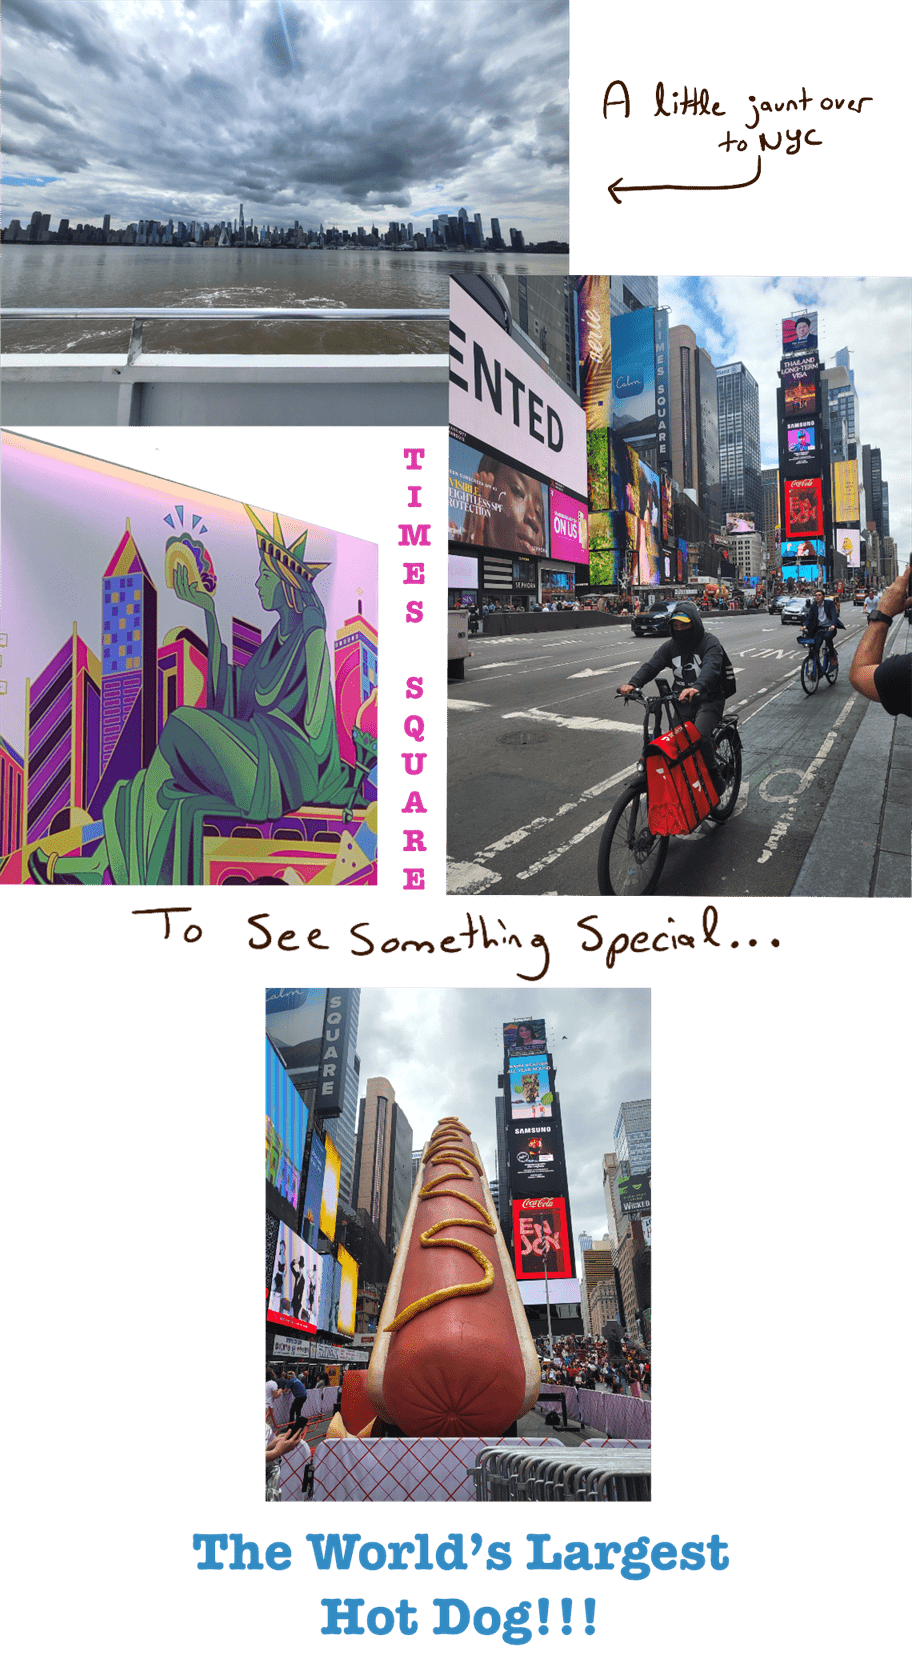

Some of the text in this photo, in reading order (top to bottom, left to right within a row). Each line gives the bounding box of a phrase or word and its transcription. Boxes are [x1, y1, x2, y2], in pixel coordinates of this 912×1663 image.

[580, 309, 604, 364] aerie
[655, 317, 666, 376] TIMES
[780, 363, 819, 375] LONG-TERM
[783, 357, 816, 368] THAILAND
[615, 374, 643, 390] Calm
[791, 371, 808, 380] VISA
[448, 319, 564, 453] ENTED
[656, 384, 668, 454] SQUARE
[787, 420, 815, 429] SAMSUNG
[553, 516, 566, 536] ON
[568, 521, 578, 539] US
[515, 581, 536, 589] SEPHORA
[321, 996, 342, 1096] SQUARE
[514, 1126, 552, 1135] SAMSUNG
